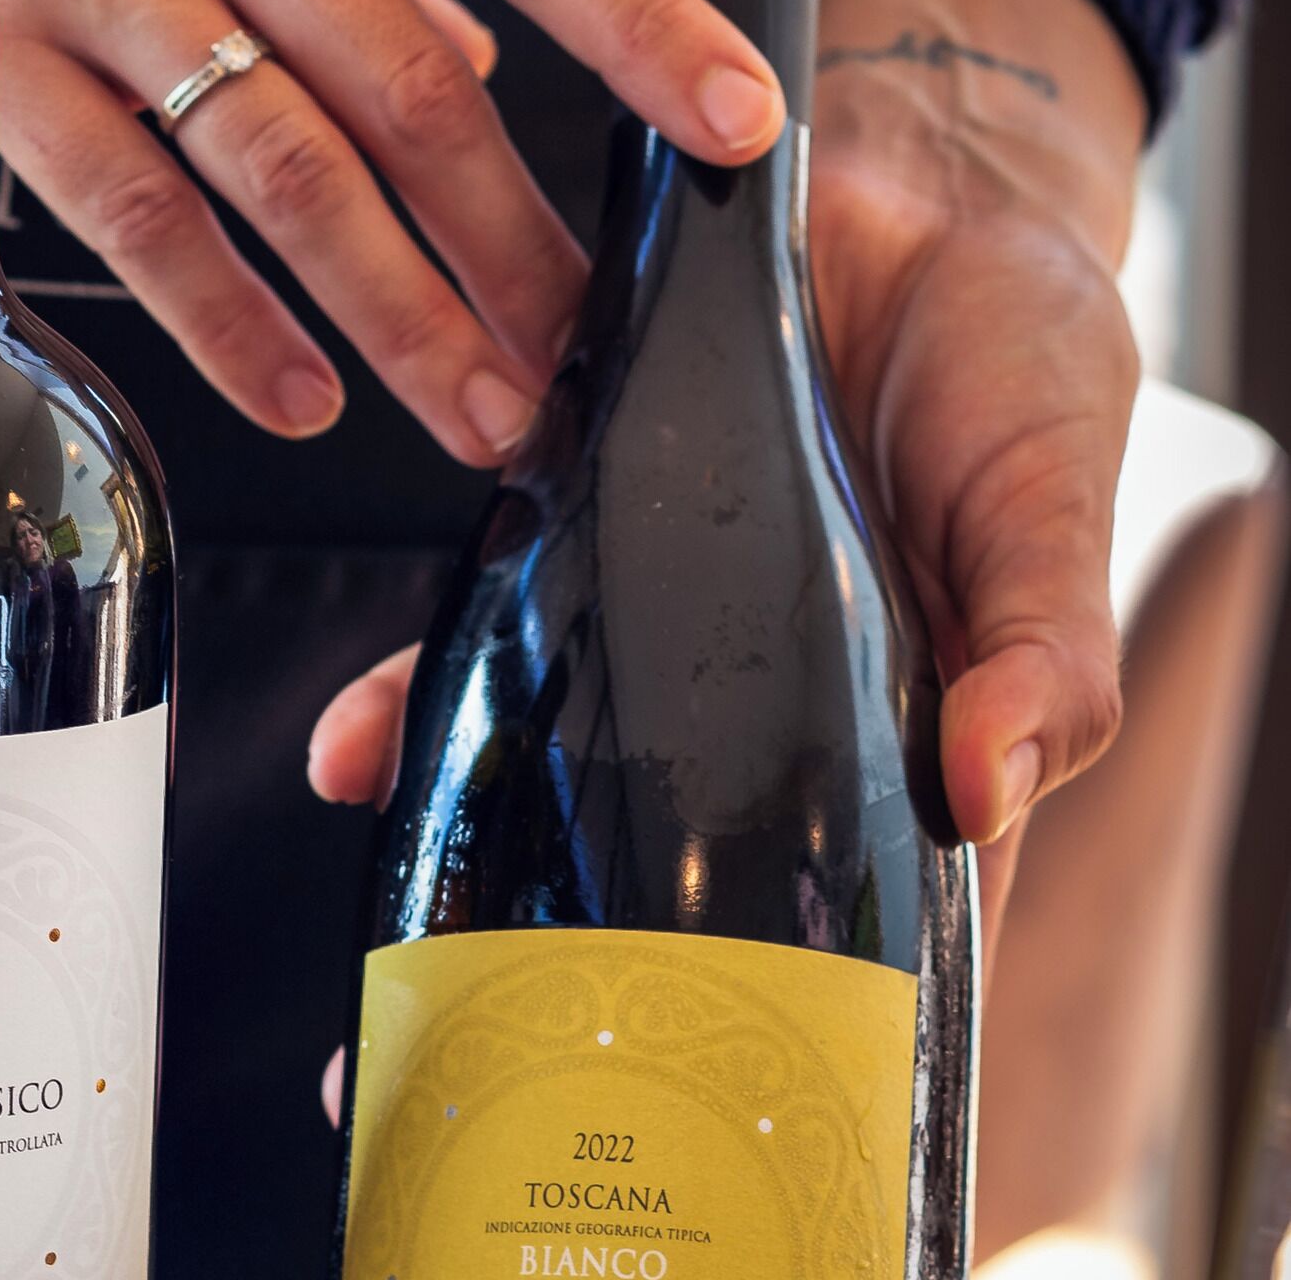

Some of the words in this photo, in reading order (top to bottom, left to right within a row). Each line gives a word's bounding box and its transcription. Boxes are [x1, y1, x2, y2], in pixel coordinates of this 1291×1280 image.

[572, 1131, 636, 1163] 2022
[523, 1182, 674, 1214] TOSCANA
[484, 1221, 572, 1235] INDICAZIONE
[575, 1222, 663, 1239] GEOGRAFICA
[666, 1228, 712, 1244] TIPICA
